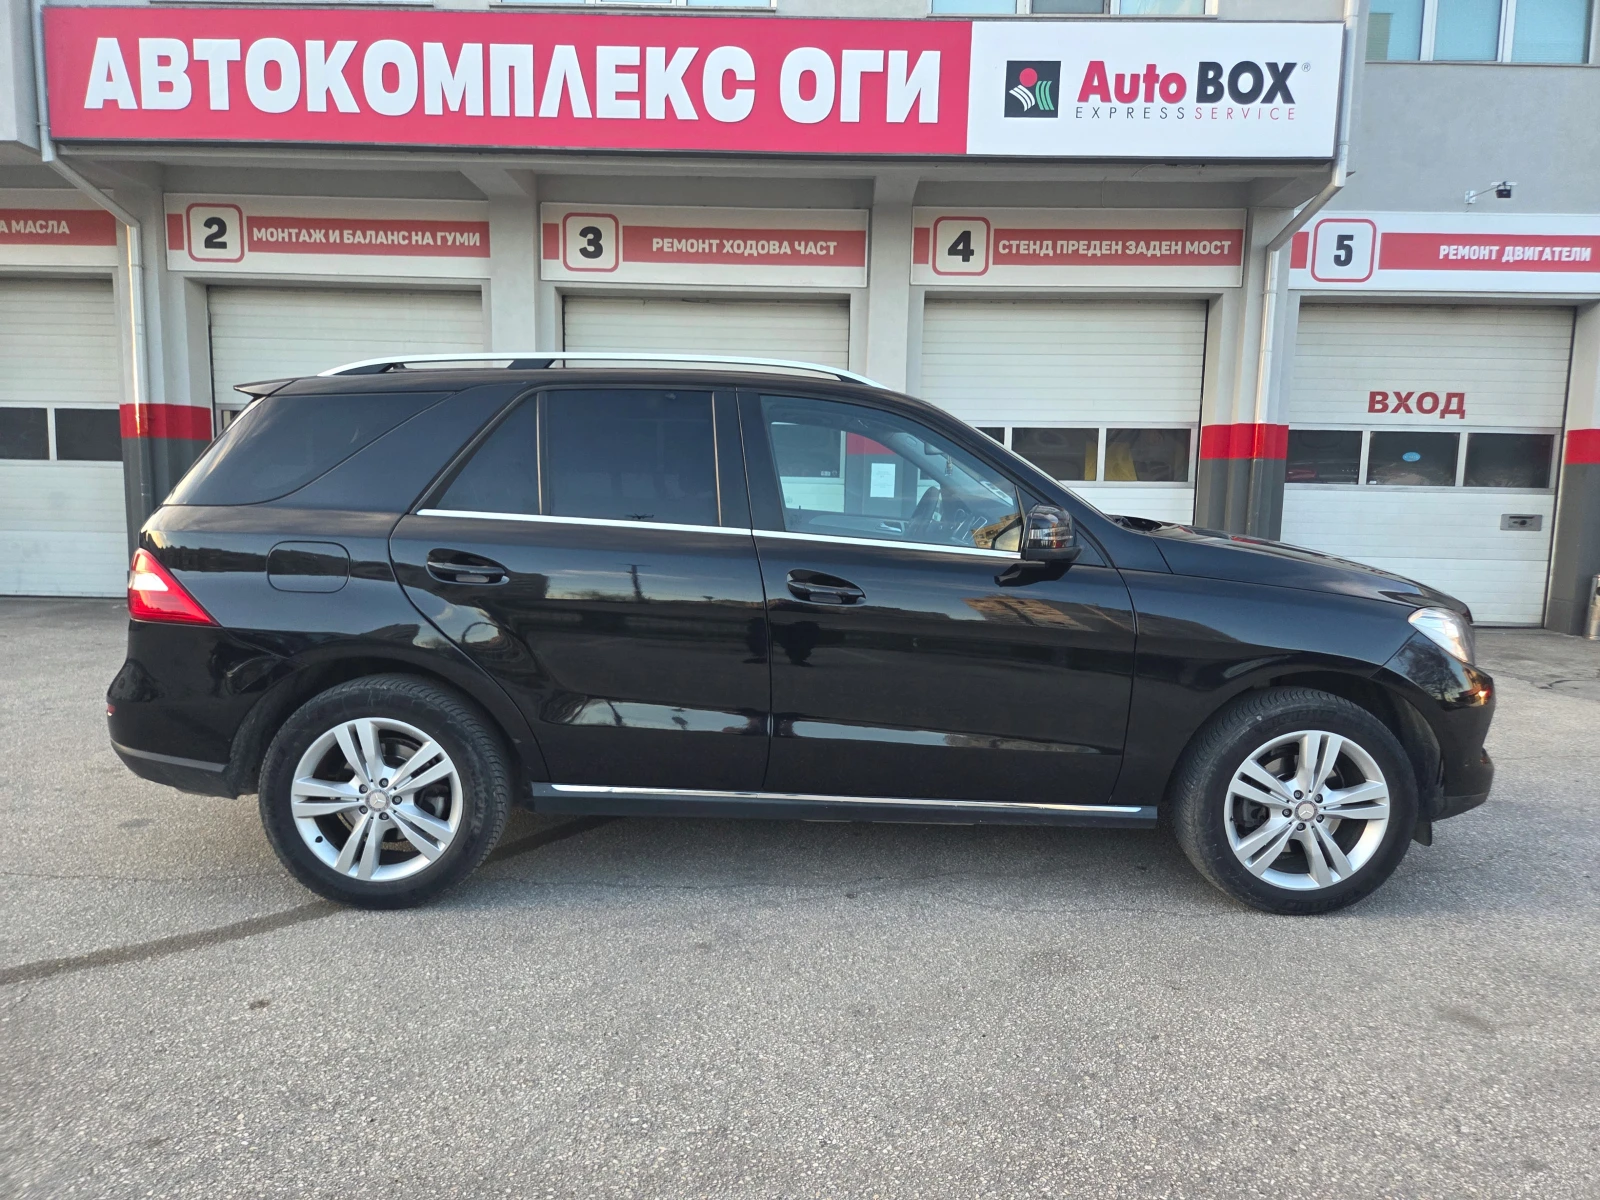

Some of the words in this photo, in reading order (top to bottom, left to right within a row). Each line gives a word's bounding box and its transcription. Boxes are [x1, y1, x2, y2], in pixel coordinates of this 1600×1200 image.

[84, 37, 756, 124] АВТОКОМПЛЕКС
[779, 46, 941, 124] ОГИ
[1076, 60, 1188, 104] Auto
[1195, 60, 1298, 105] BOX
[11, 219, 71, 235] МАСЛА
[203, 216, 228, 250] 2
[252, 227, 326, 244] МОНТАЖ
[328, 229, 341, 244] И
[343, 229, 409, 245] БАЛАНС
[411, 230, 434, 246] НА
[436, 232, 481, 247] ГУМИ
[578, 226, 604, 259] 3
[652, 237, 720, 255] РЕМОНТ
[722, 239, 792, 257] ХОДОВА
[794, 240, 838, 256] ЧАСТ
[947, 230, 975, 263] 4
[998, 240, 1054, 256] СТЕНД
[1056, 240, 1121, 256] ПРЕДЕН
[1125, 240, 1180, 257] ЗАДЕН
[1184, 240, 1232, 256] МОСТ
[1333, 234, 1354, 267] 5
[1438, 245, 1500, 261] РЕМОНТ
[1501, 246, 1592, 263] ДВИГАТЕЛИ
[1367, 391, 1466, 420] ВХОД
